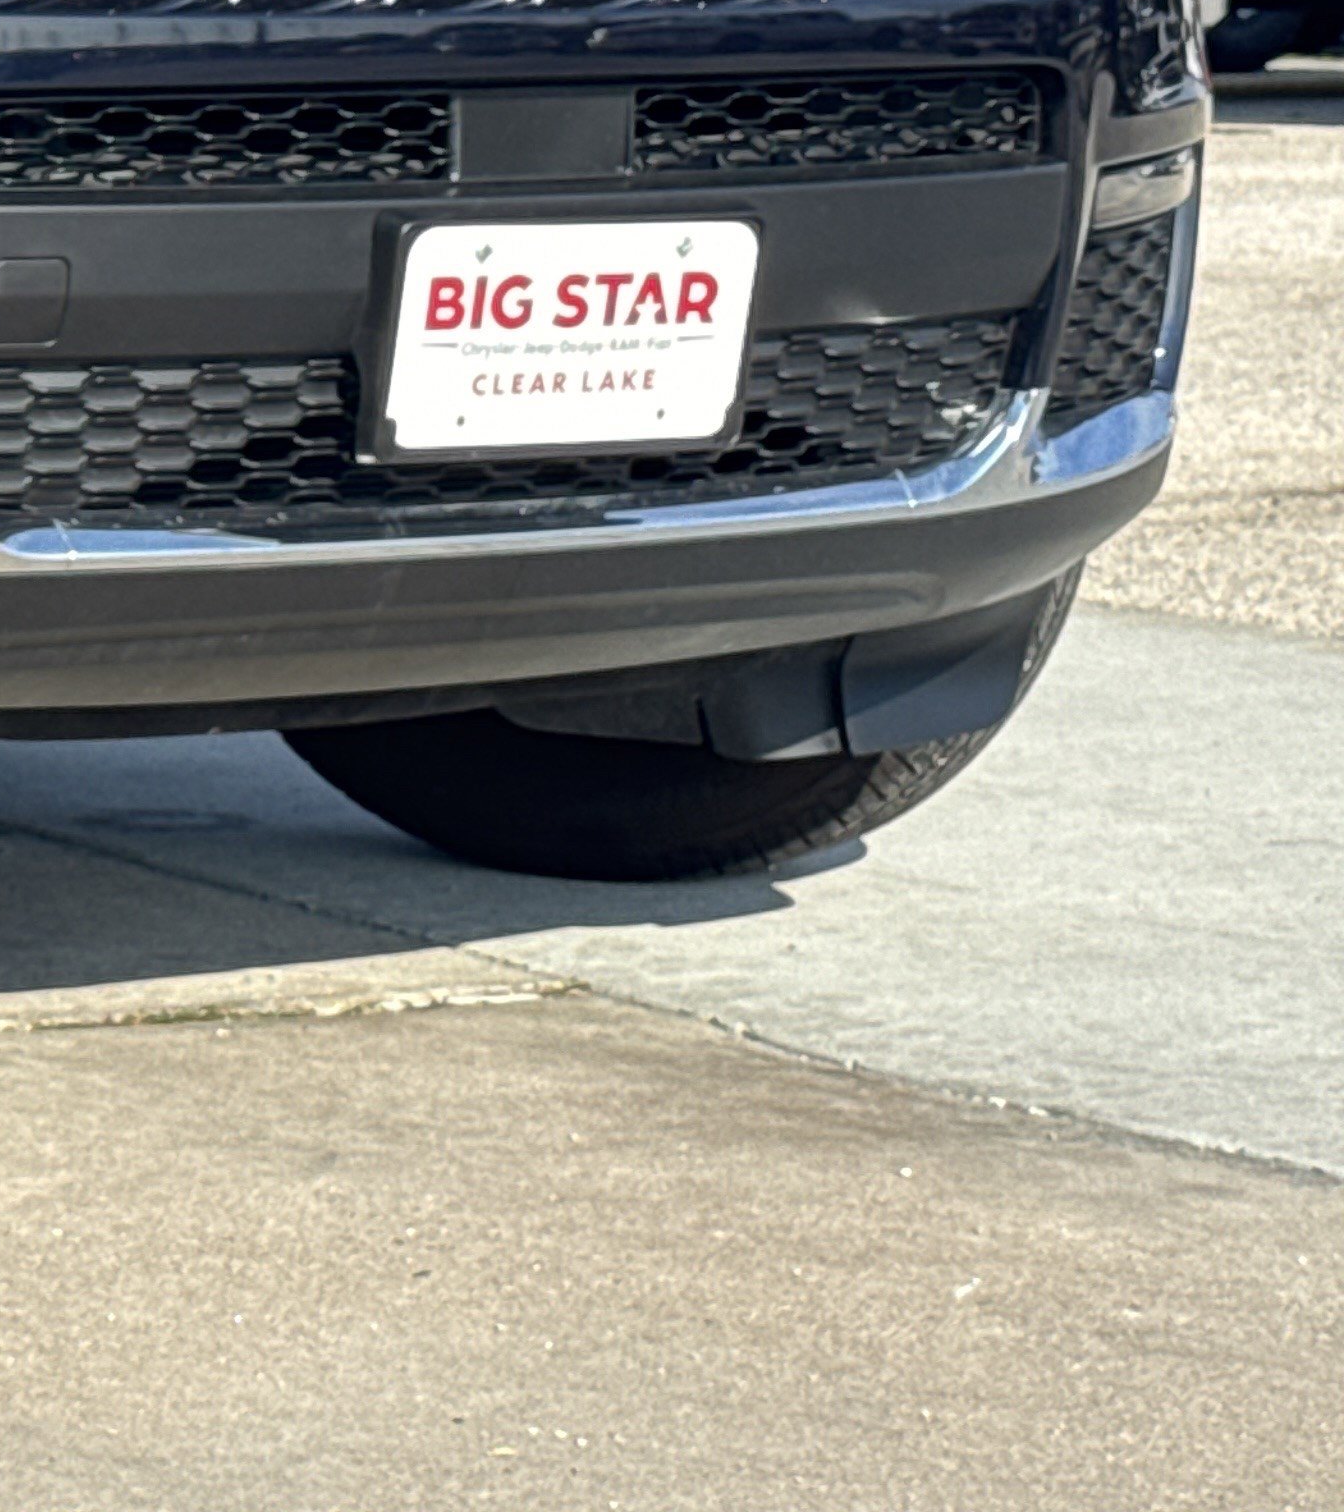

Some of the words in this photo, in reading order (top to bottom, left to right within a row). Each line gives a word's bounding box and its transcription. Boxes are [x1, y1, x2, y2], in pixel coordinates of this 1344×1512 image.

[424, 274, 534, 331] BIG
[552, 271, 719, 329] STAR
[471, 371, 567, 397] CLEAR
[581, 368, 657, 393] LAKE
